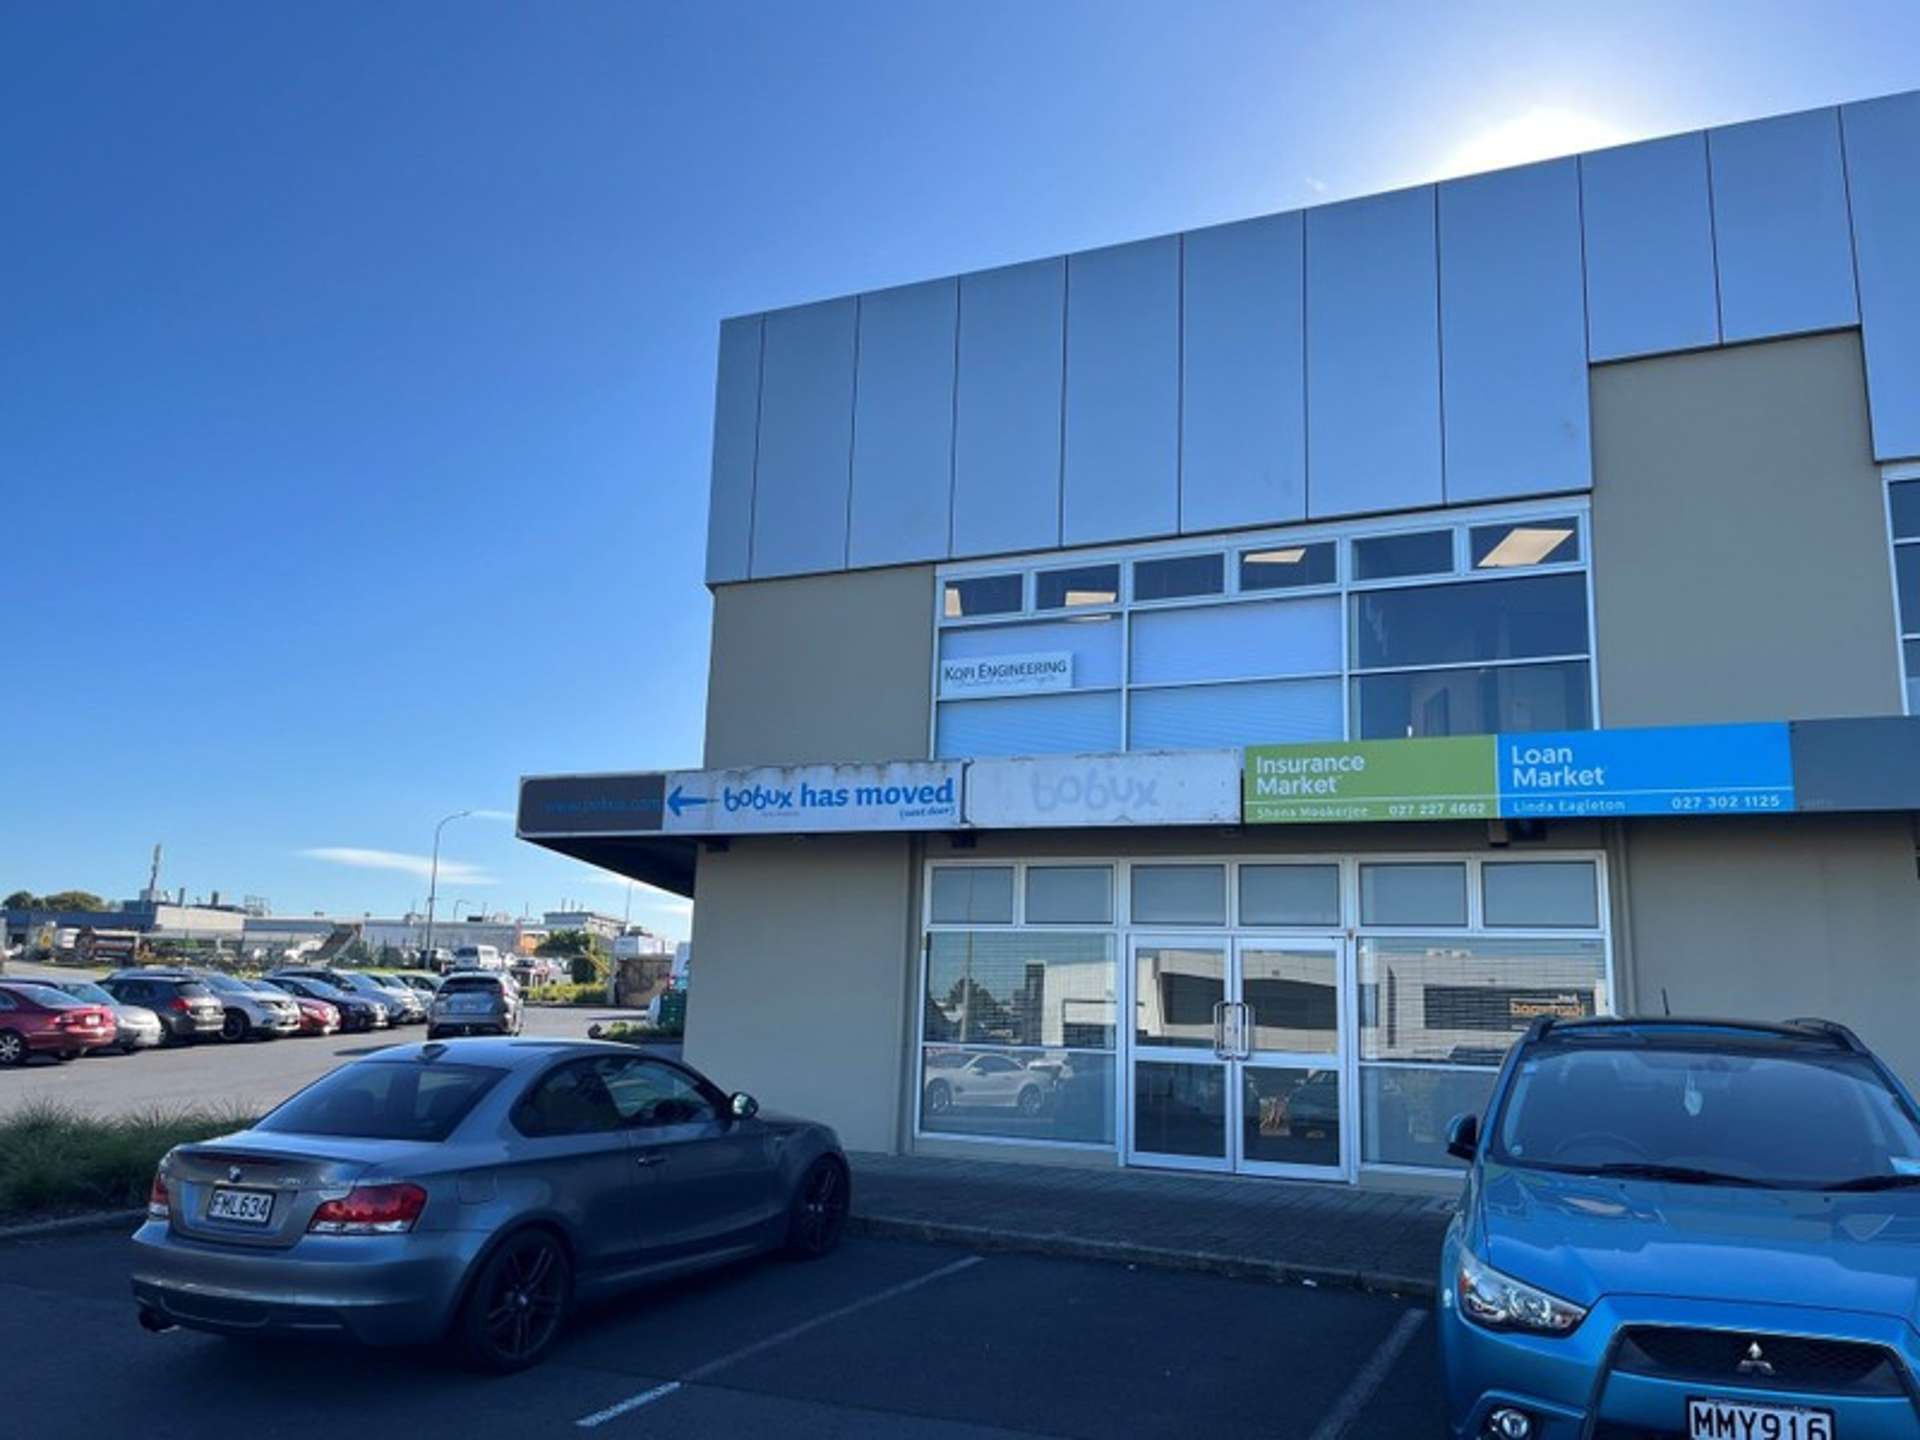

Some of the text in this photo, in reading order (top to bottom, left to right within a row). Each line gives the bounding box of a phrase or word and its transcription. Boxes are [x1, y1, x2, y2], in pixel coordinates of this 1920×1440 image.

[978, 660, 1067, 680] ENGINEERING
[1256, 755, 1366, 775] Insurance
[1511, 745, 1574, 766] Loan
[1256, 775, 1338, 796] Market
[1512, 765, 1606, 788] Market
[724, 777, 954, 812] bobux has moved
[1031, 767, 1159, 812] bobux
[1388, 804, 1415, 817] 027
[1420, 803, 1446, 816] 227
[1672, 793, 1781, 810] 027 302 1125
[1694, 1405, 1828, 1440] MMY916
